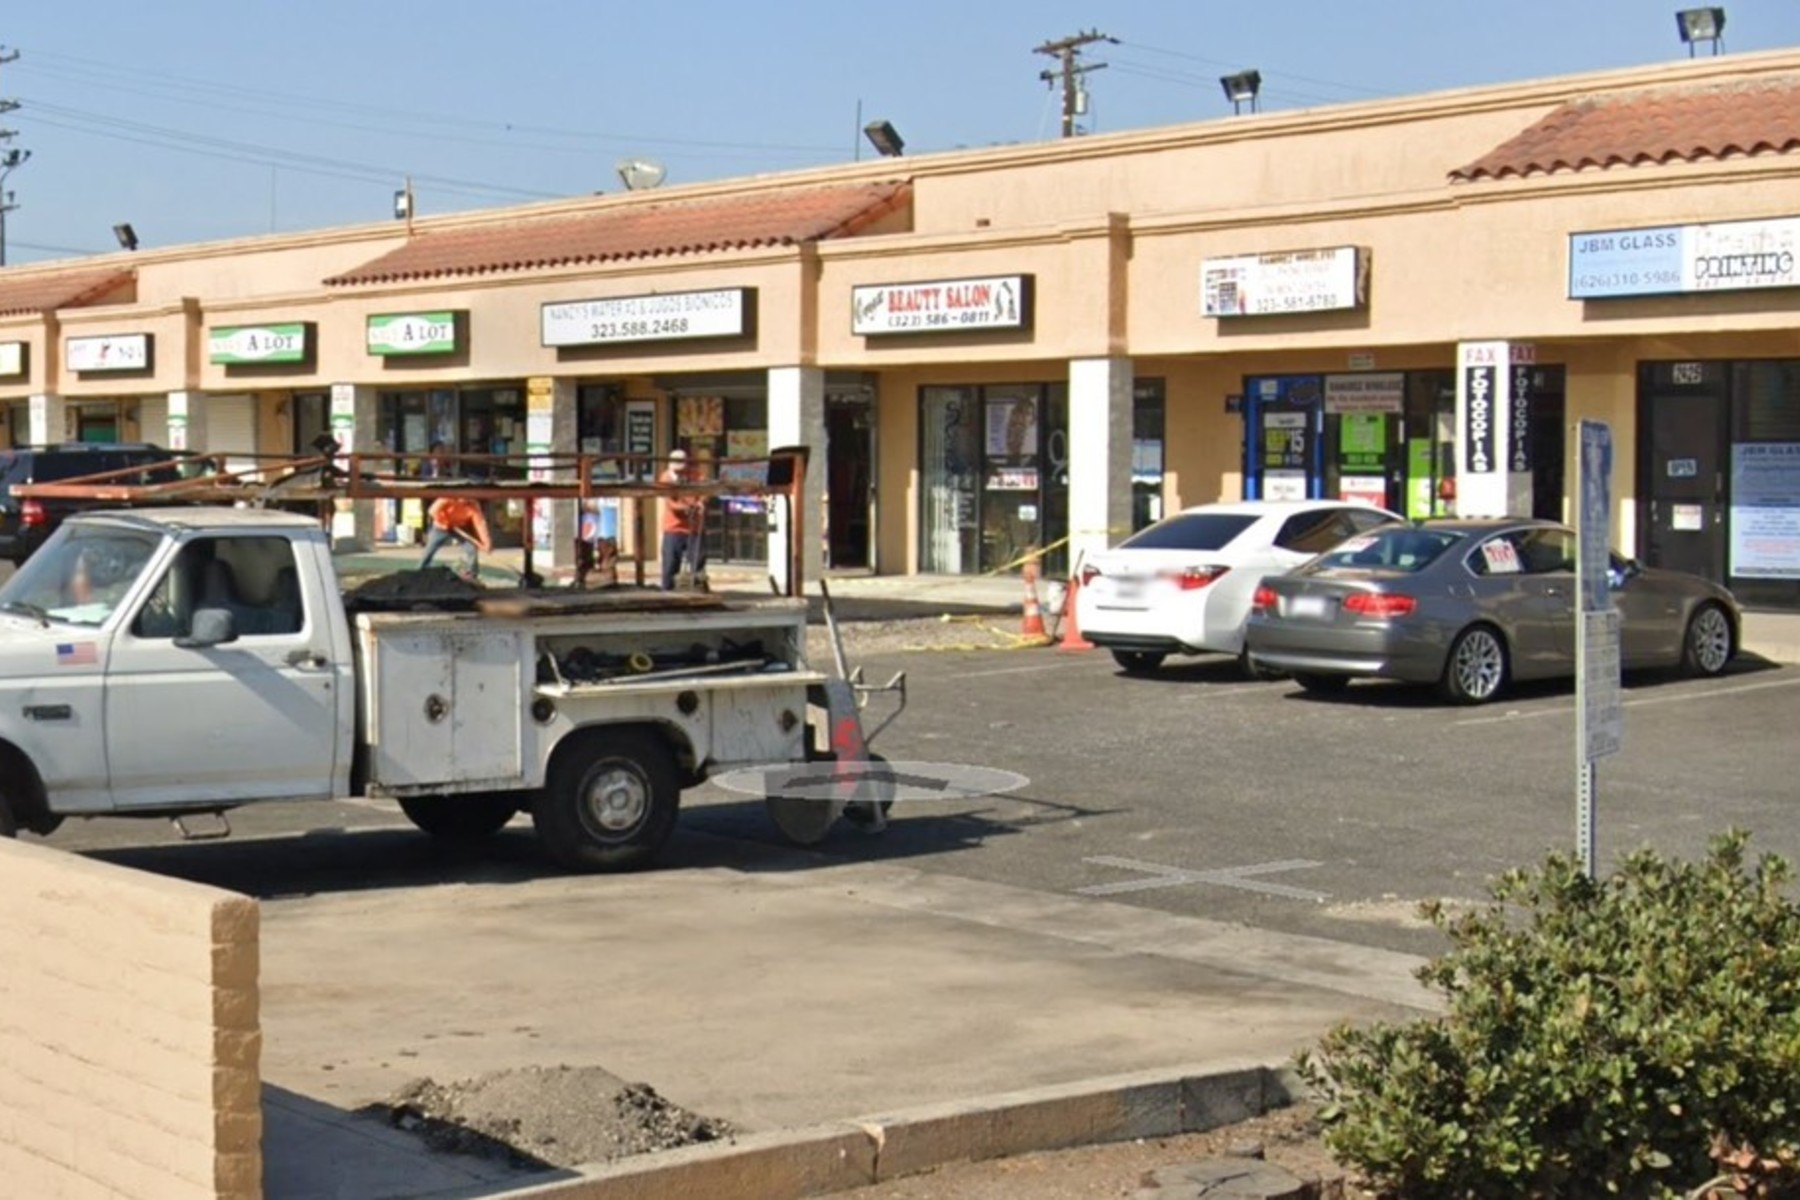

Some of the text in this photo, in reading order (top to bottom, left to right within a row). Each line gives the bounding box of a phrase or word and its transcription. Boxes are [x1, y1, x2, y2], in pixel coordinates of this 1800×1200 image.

[1579, 237, 1614, 254] JBM
[1619, 233, 1677, 251] GLASS
[1695, 251, 1794, 280] PRINTING
[888, 287, 941, 313] BEAUTY
[945, 284, 992, 310] SALON
[402, 323, 414, 341] A
[419, 324, 447, 341] LOT
[591, 318, 689, 339] 323.588.2468
[247, 334, 259, 351] A
[264, 335, 294, 350] LOT
[1466, 347, 1495, 363] FAX
[1510, 345, 1535, 363] FAX
[1471, 368, 1490, 472] FOTOCOPIAS
[1514, 367, 1529, 472] FOTOCOPIAS
